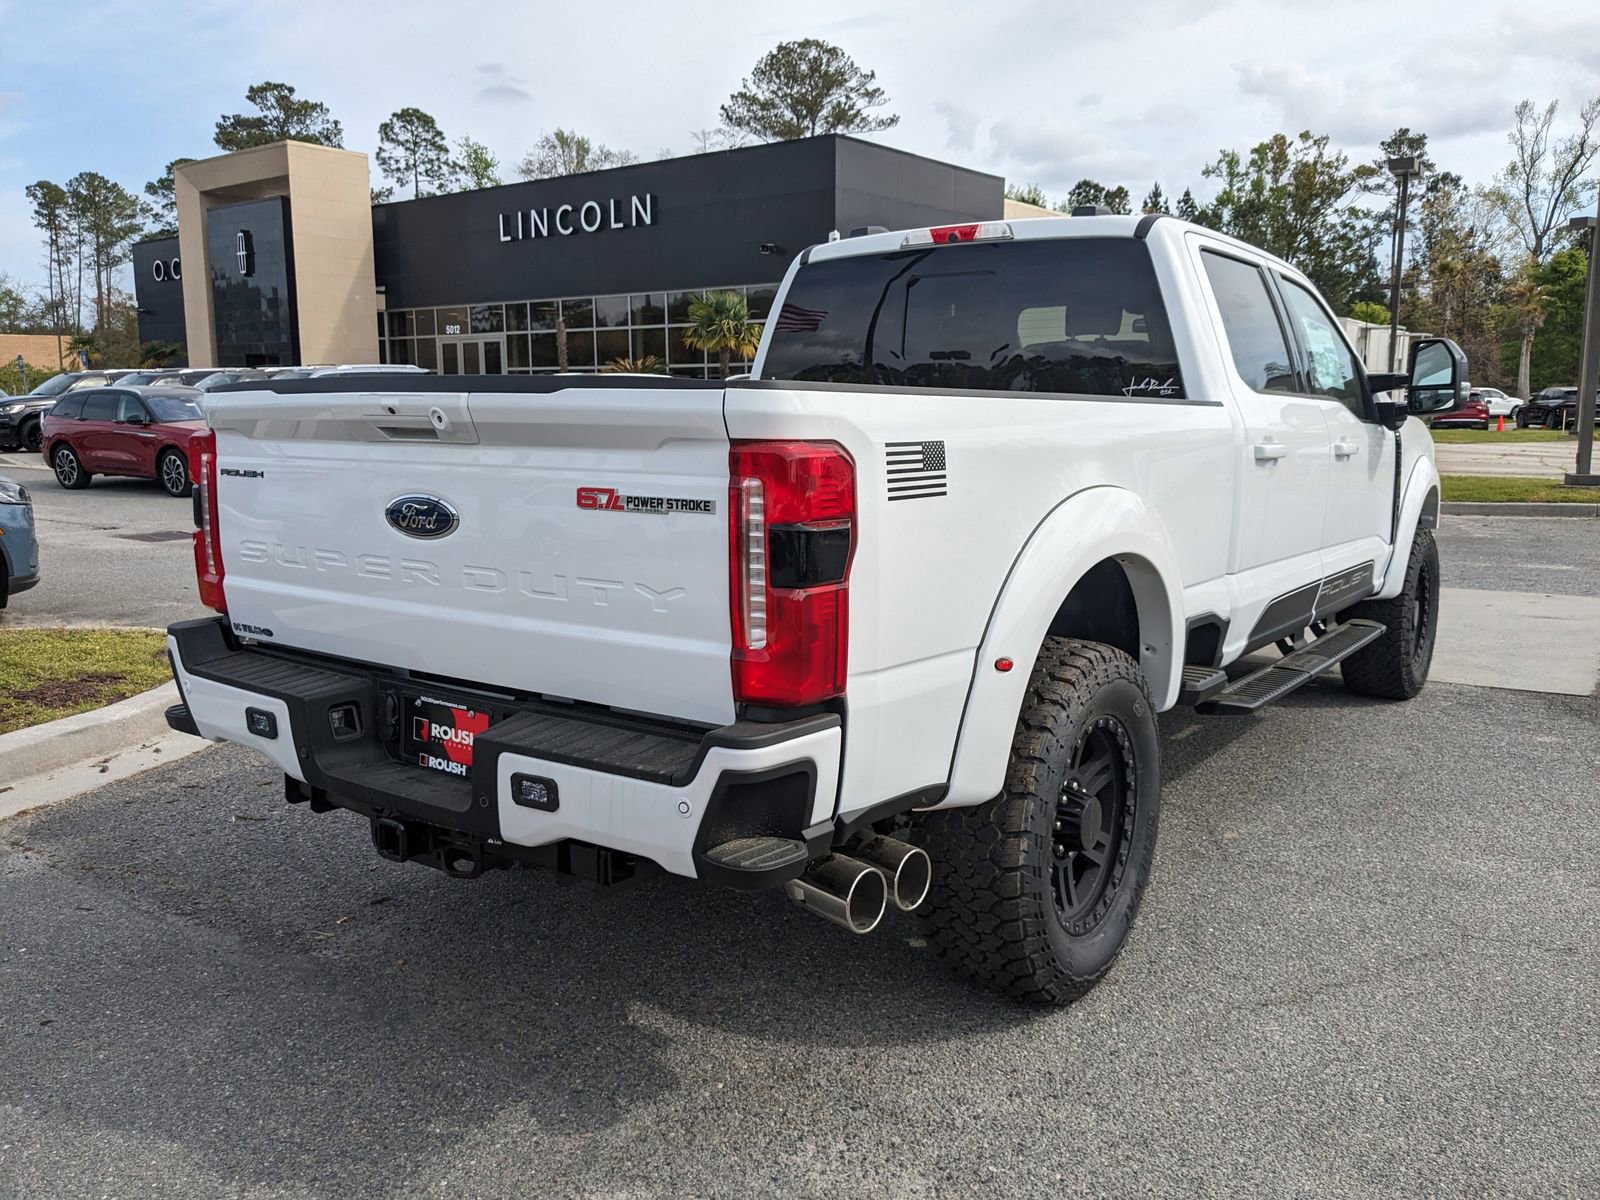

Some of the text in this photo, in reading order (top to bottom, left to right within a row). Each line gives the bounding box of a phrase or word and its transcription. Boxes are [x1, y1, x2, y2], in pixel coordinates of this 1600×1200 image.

[499, 193, 652, 242] LINCOLN
[446, 324, 461, 335] 5012
[220, 468, 265, 479] ROUSH
[626, 496, 664, 509] POWER
[666, 498, 711, 512] STROKE
[400, 502, 438, 530] Ford
[240, 539, 686, 613] SUPER DUTY
[429, 755, 467, 776] ROUSH
